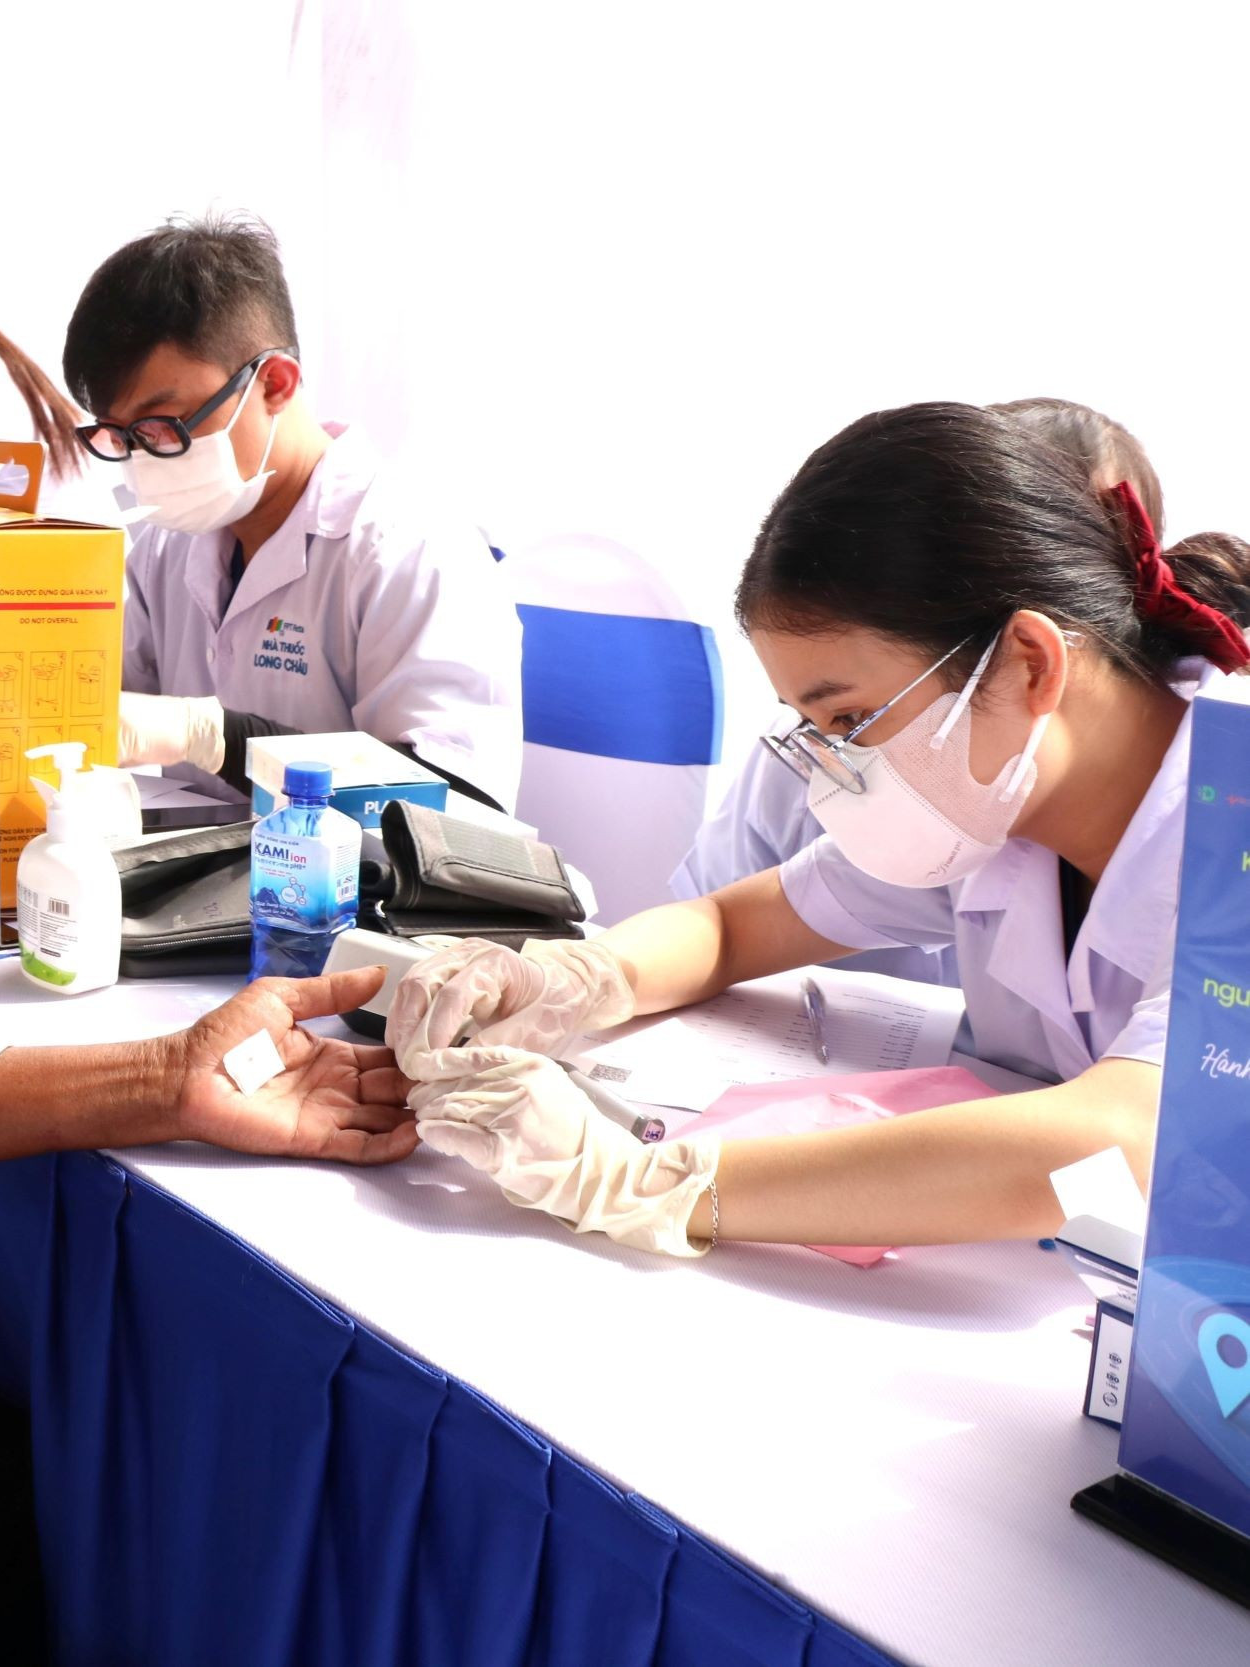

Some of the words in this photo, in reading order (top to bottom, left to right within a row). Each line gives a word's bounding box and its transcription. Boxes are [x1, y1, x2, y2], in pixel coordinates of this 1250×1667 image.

[262, 638, 278, 651] NHÀ
[279, 640, 305, 656] THUỐC
[254, 653, 282, 670] LONG
[254, 841, 289, 861] KAMI
[290, 853, 307, 864] ion
[1109, 1353, 1122, 1364] ISO
[1106, 1372, 1120, 1384] ISO
